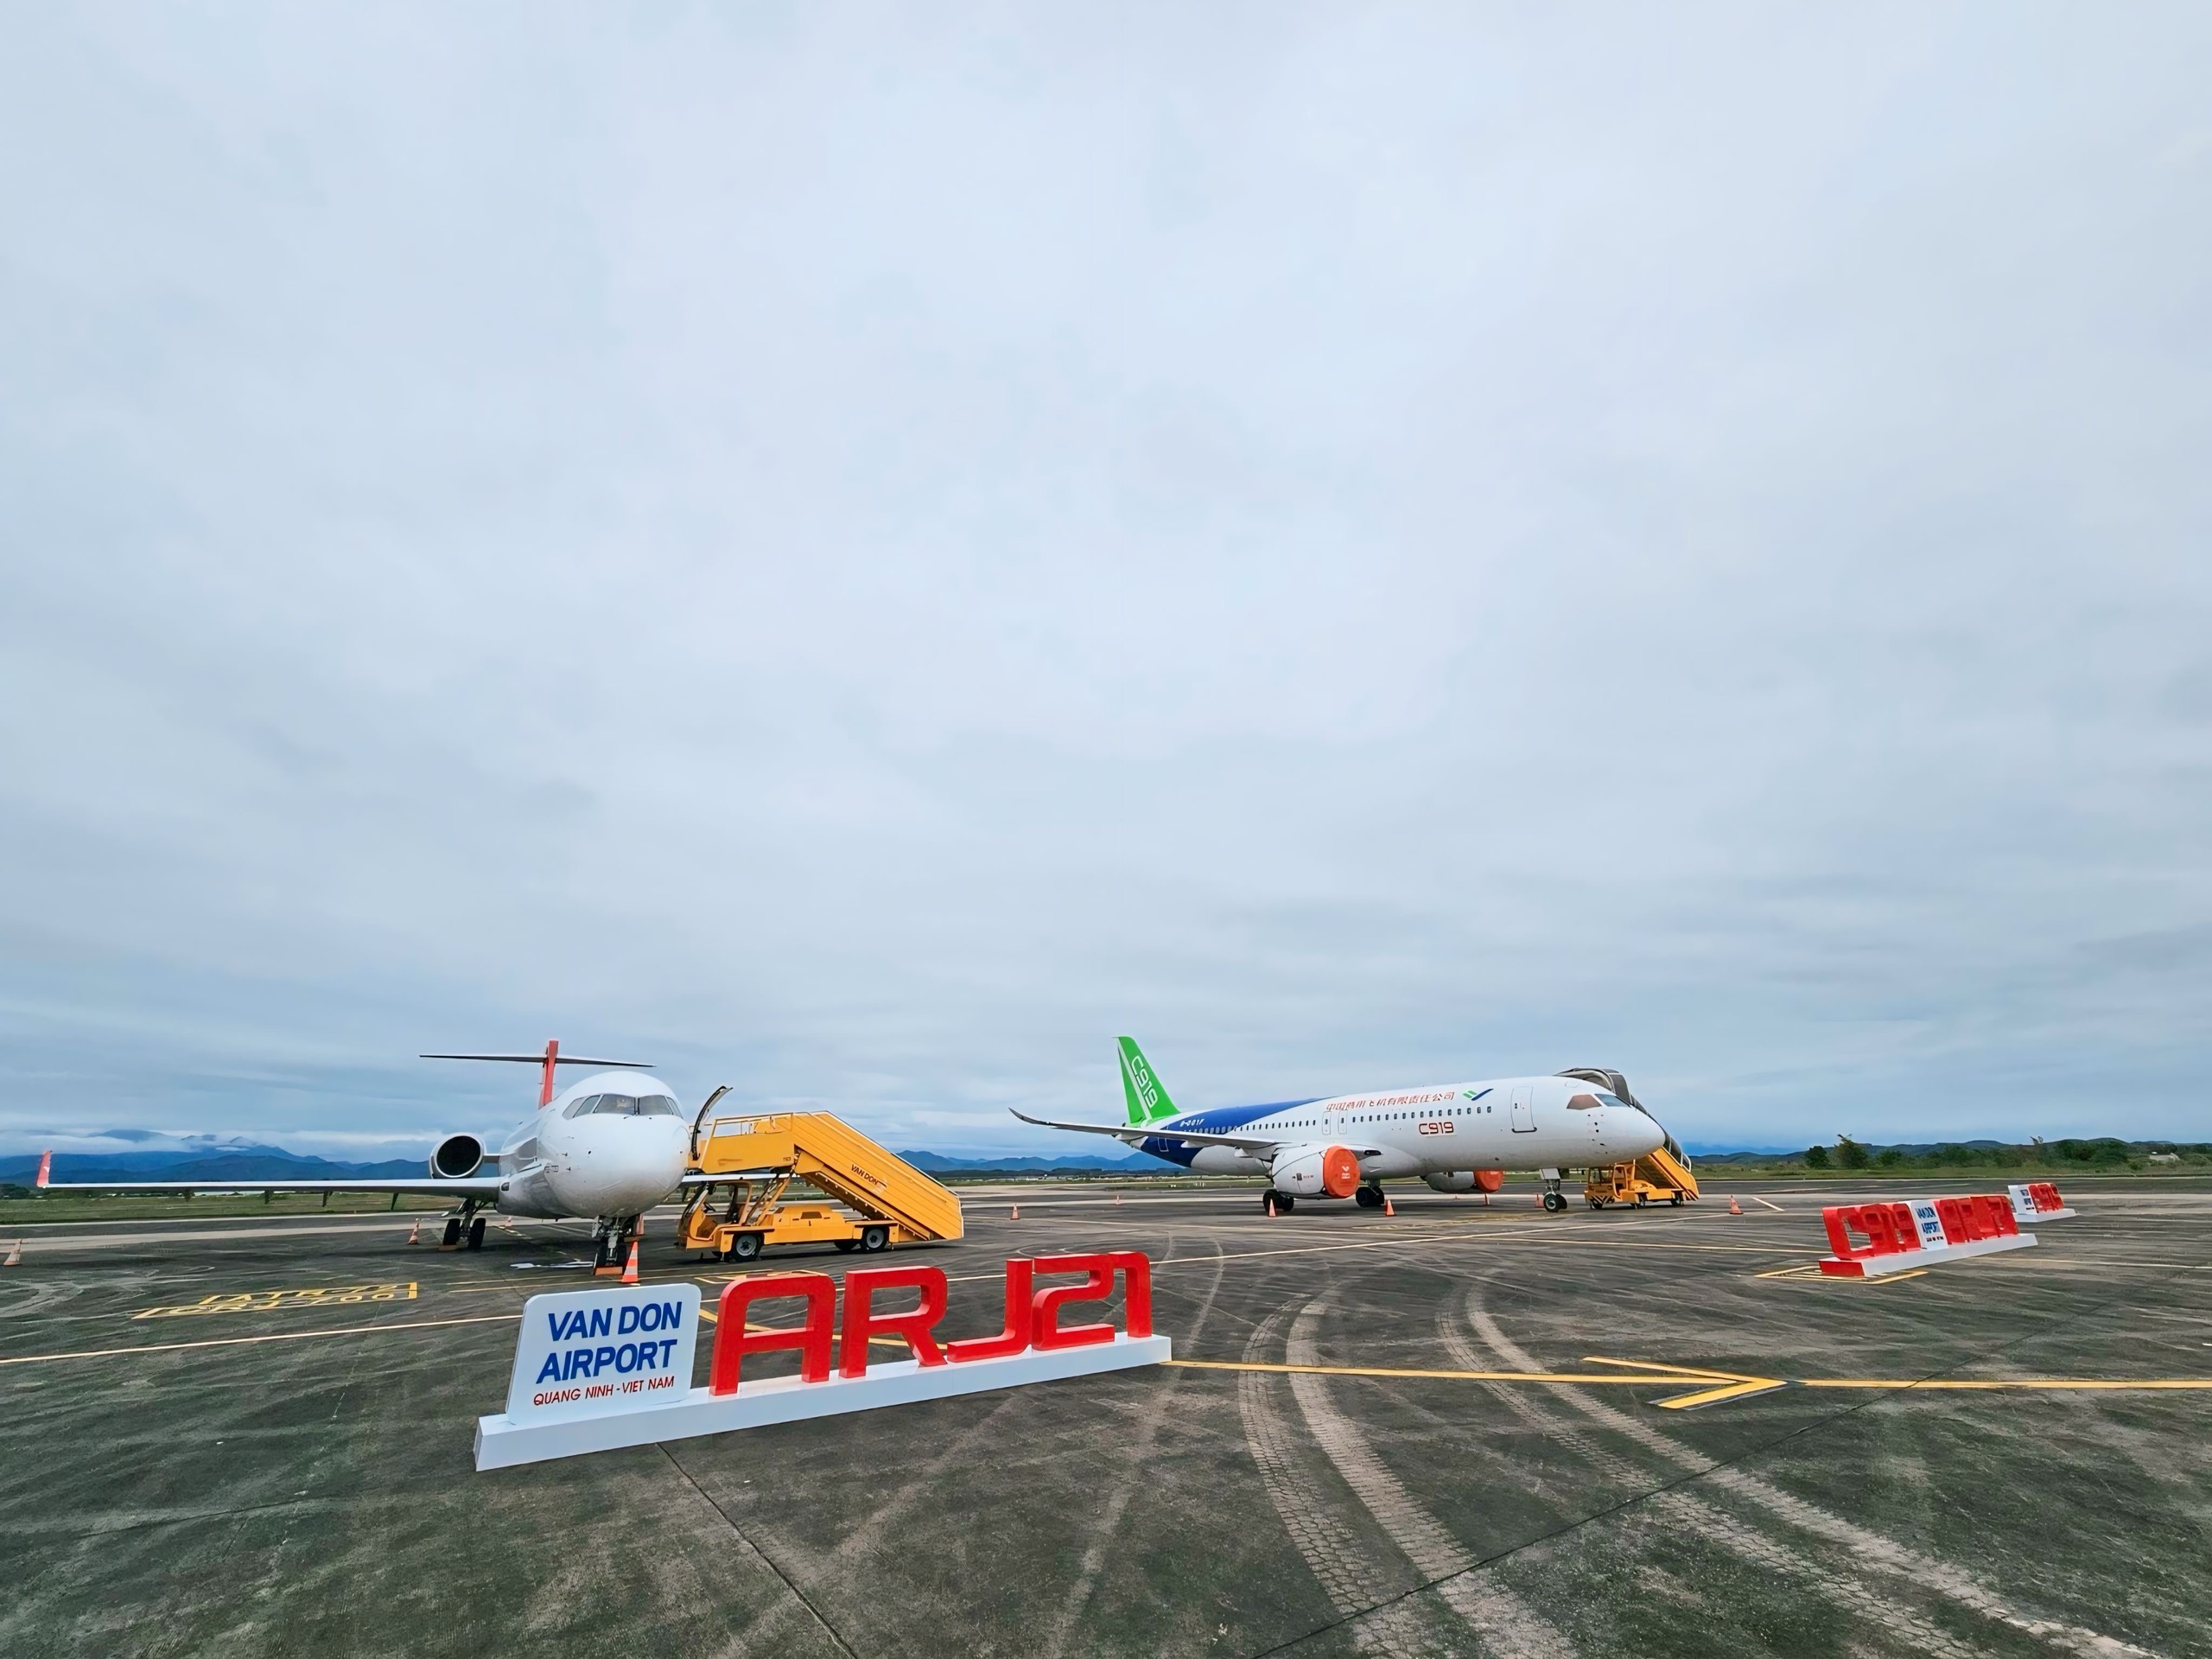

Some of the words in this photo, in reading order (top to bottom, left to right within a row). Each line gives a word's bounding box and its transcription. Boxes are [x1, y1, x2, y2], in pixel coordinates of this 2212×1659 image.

[1131, 1055, 1158, 1109] C919
[1418, 1122, 1454, 1135] C919
[851, 1164, 865, 1177] VAN
[864, 1173, 878, 1185] DON
[548, 1307, 613, 1342] VAN
[617, 1301, 683, 1335] DON
[709, 1251, 1153, 1396] ARJ21
[536, 1338, 678, 1384] AIRPORT
[533, 1388, 582, 1407] QUANG
[584, 1383, 614, 1400] NINH
[621, 1379, 645, 1394] VIET
[647, 1375, 675, 1390] NAM
